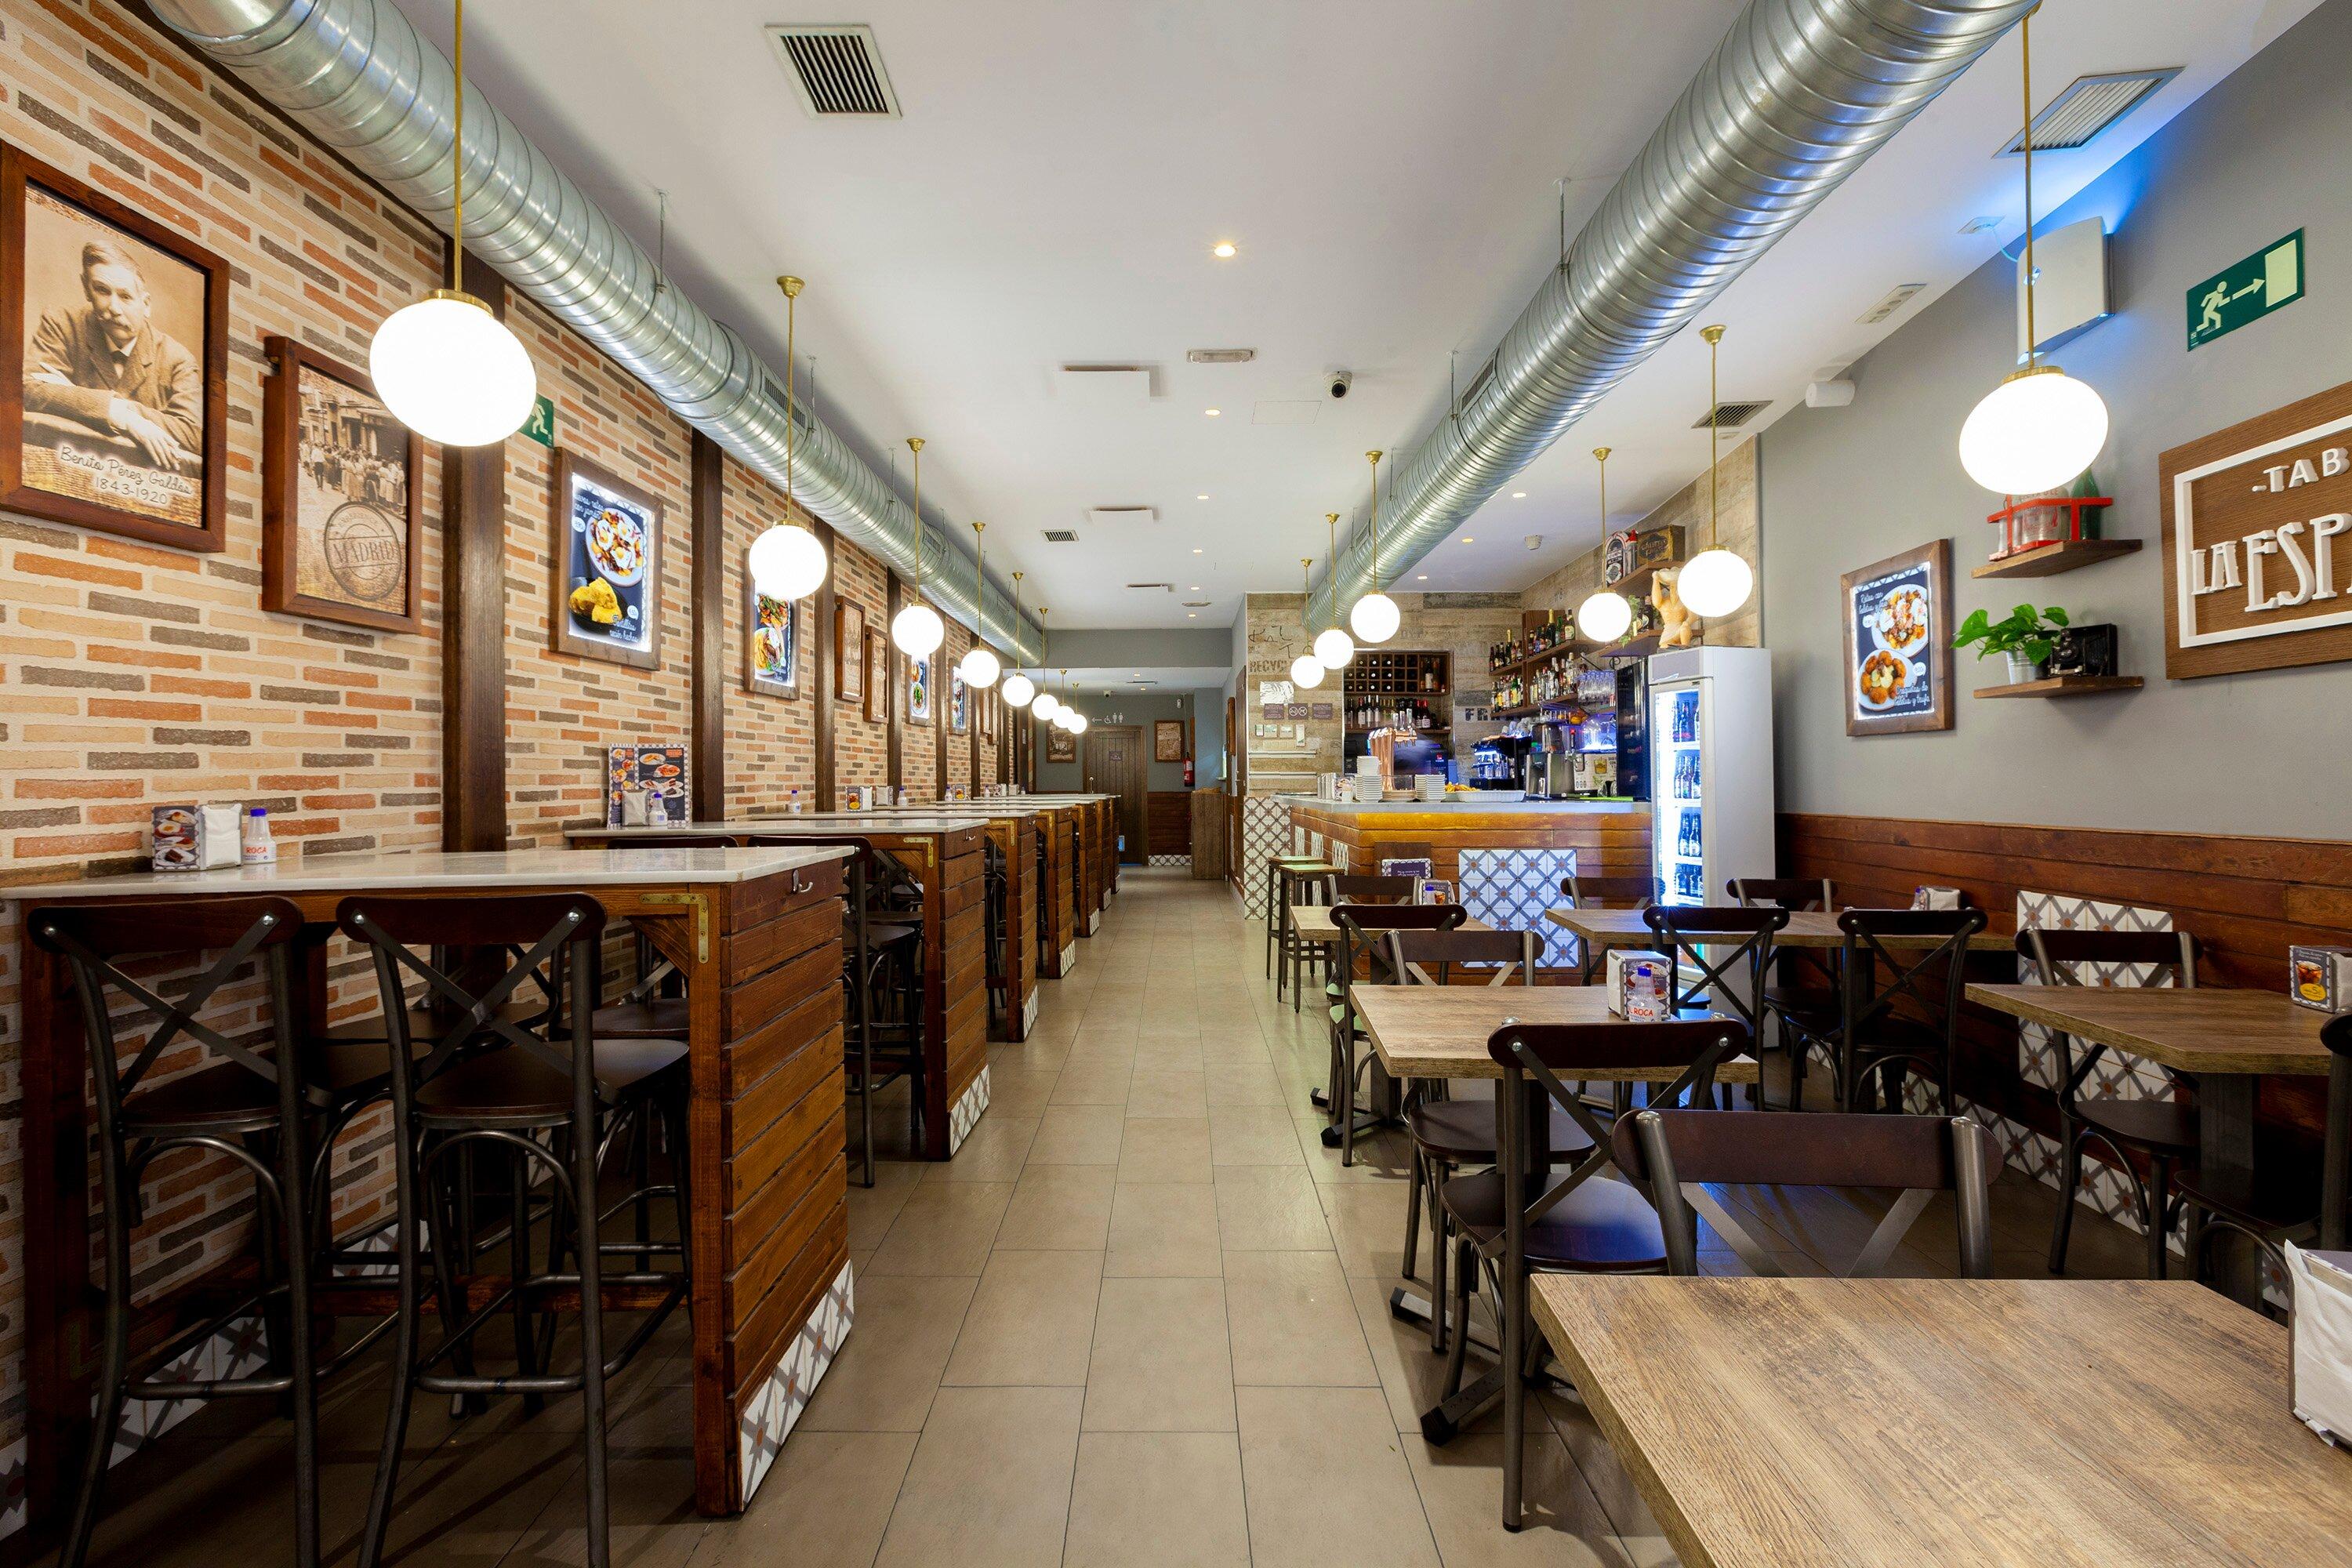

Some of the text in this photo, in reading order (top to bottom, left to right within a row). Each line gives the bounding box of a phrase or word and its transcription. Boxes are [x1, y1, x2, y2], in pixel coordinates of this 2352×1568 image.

[60, 446, 104, 470] Benito
[94, 477, 168, 505] 1843-1920
[2190, 513, 2352, 613] LA ESP
